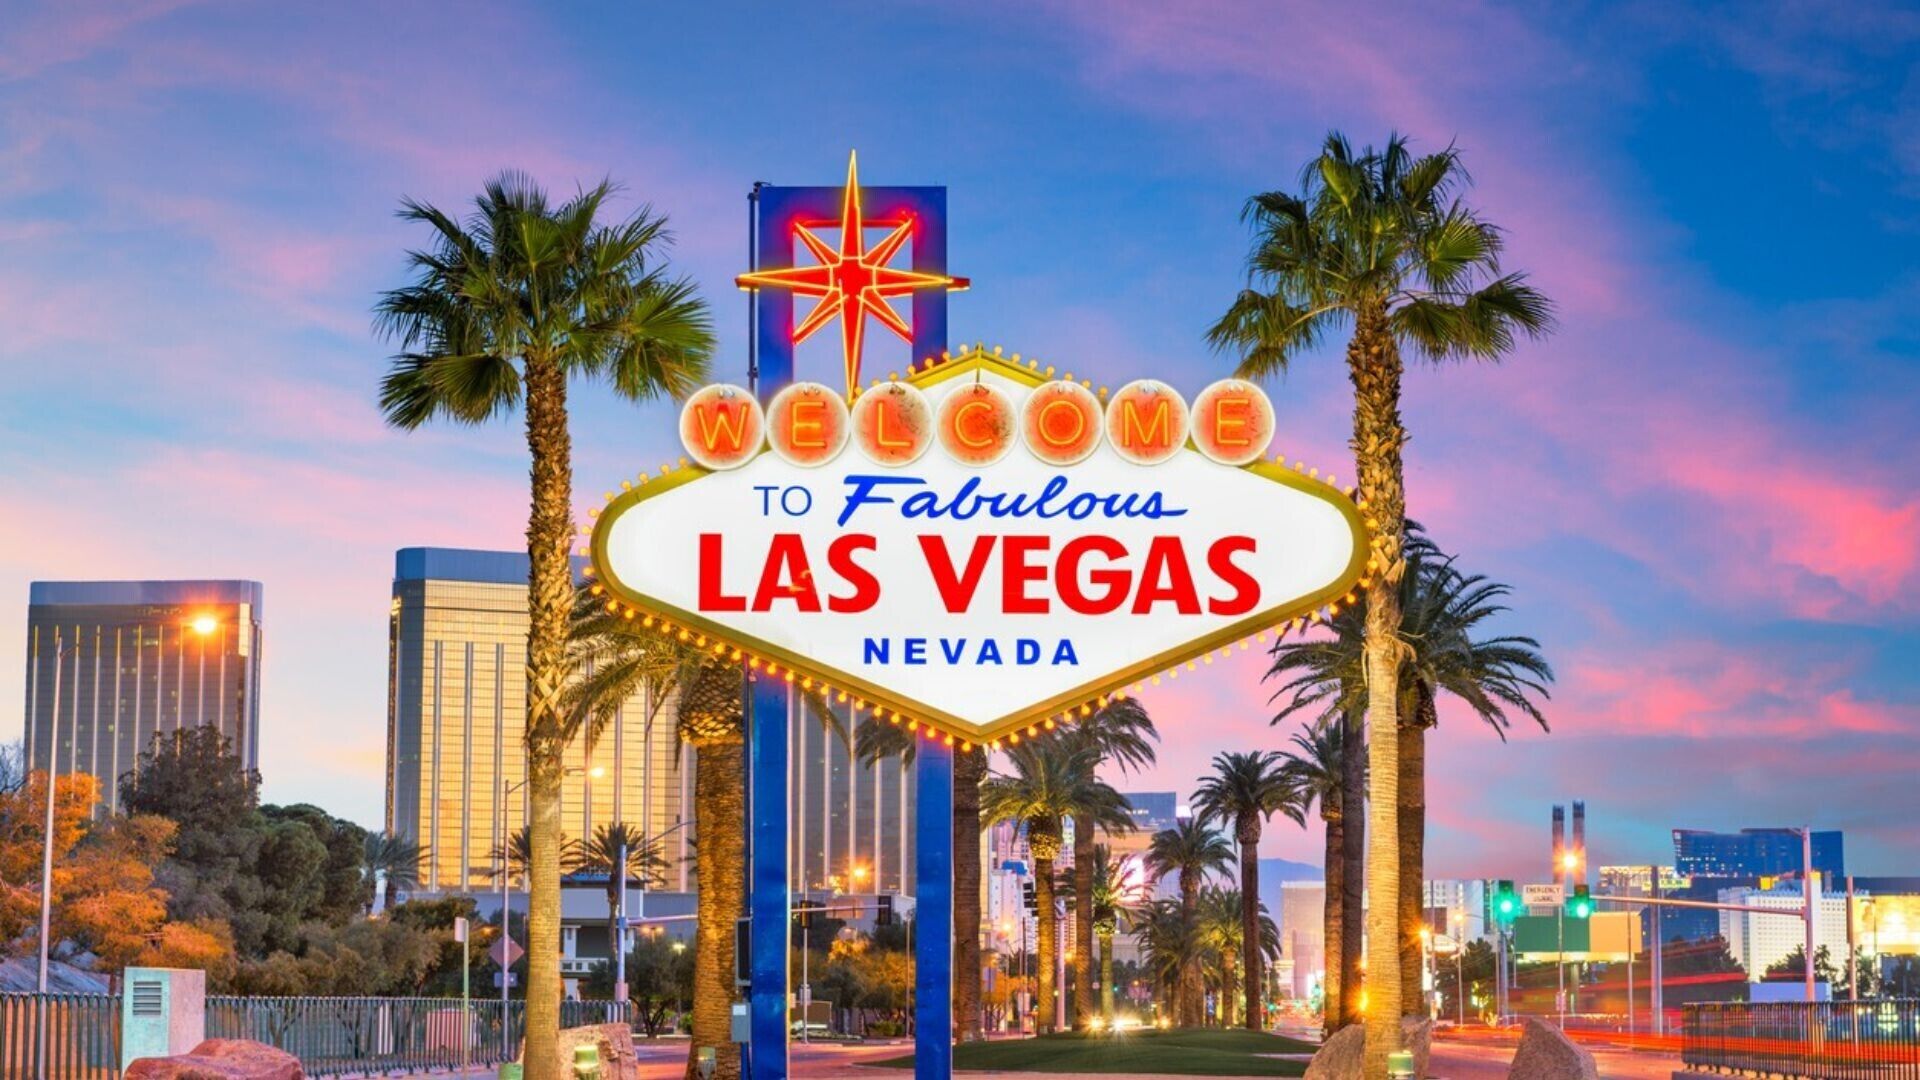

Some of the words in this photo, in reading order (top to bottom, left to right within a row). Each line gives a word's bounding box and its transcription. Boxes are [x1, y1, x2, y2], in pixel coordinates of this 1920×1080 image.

[694, 398, 1250, 451] WELCOME
[753, 486, 813, 516] TO
[837, 474, 1188, 527] Fabulous
[697, 533, 881, 614] LAS
[918, 534, 1261, 617] VEGAS
[863, 637, 1080, 666] NEVADA
